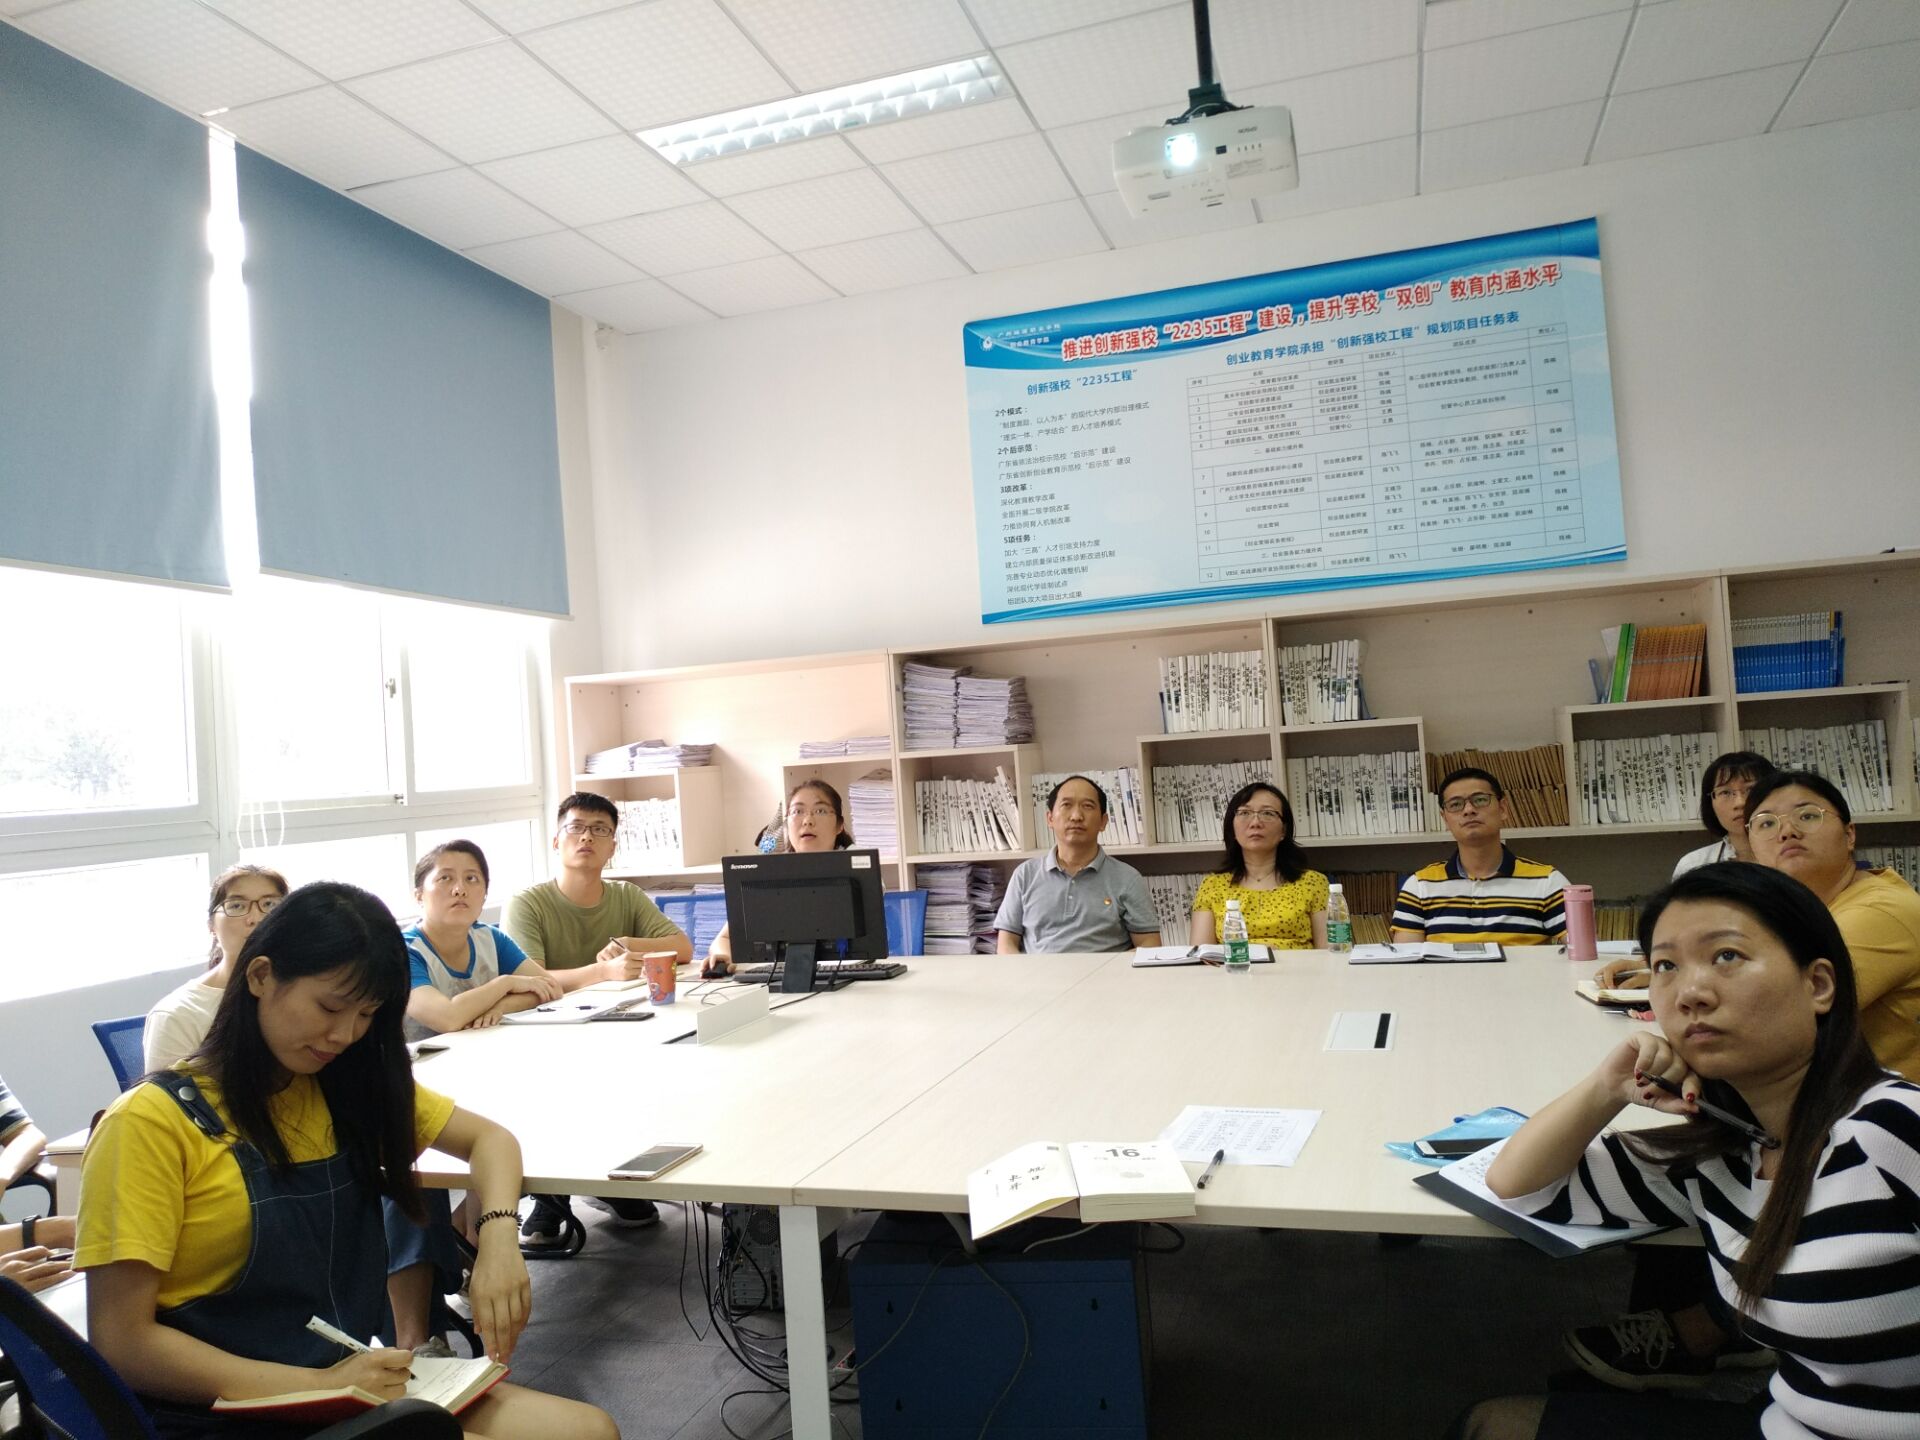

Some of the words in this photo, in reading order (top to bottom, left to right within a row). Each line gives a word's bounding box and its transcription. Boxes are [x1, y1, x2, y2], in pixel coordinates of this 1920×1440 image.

[1062, 261, 1562, 361] 推进创新强校“2235工程”建设，提升学校“双创”教育内涵水平
[1224, 310, 1520, 366] 创业教育学院承担“创新强校工程”规划项目任务表
[1026, 369, 1138, 394] 创新强校“2235工程”
[994, 405, 1028, 417] 2个模式：
[997, 443, 1039, 455] 2个后示范：
[999, 483, 1034, 493] 3项改革：
[1000, 493, 1055, 506] 深化教育教学改革
[1000, 504, 1070, 518] 全面开展二级学院改革
[1001, 516, 1071, 530] 力推协同育人机制改革
[1003, 533, 1037, 544] 5项任务：
[1106, 1148, 1140, 1158] 16
